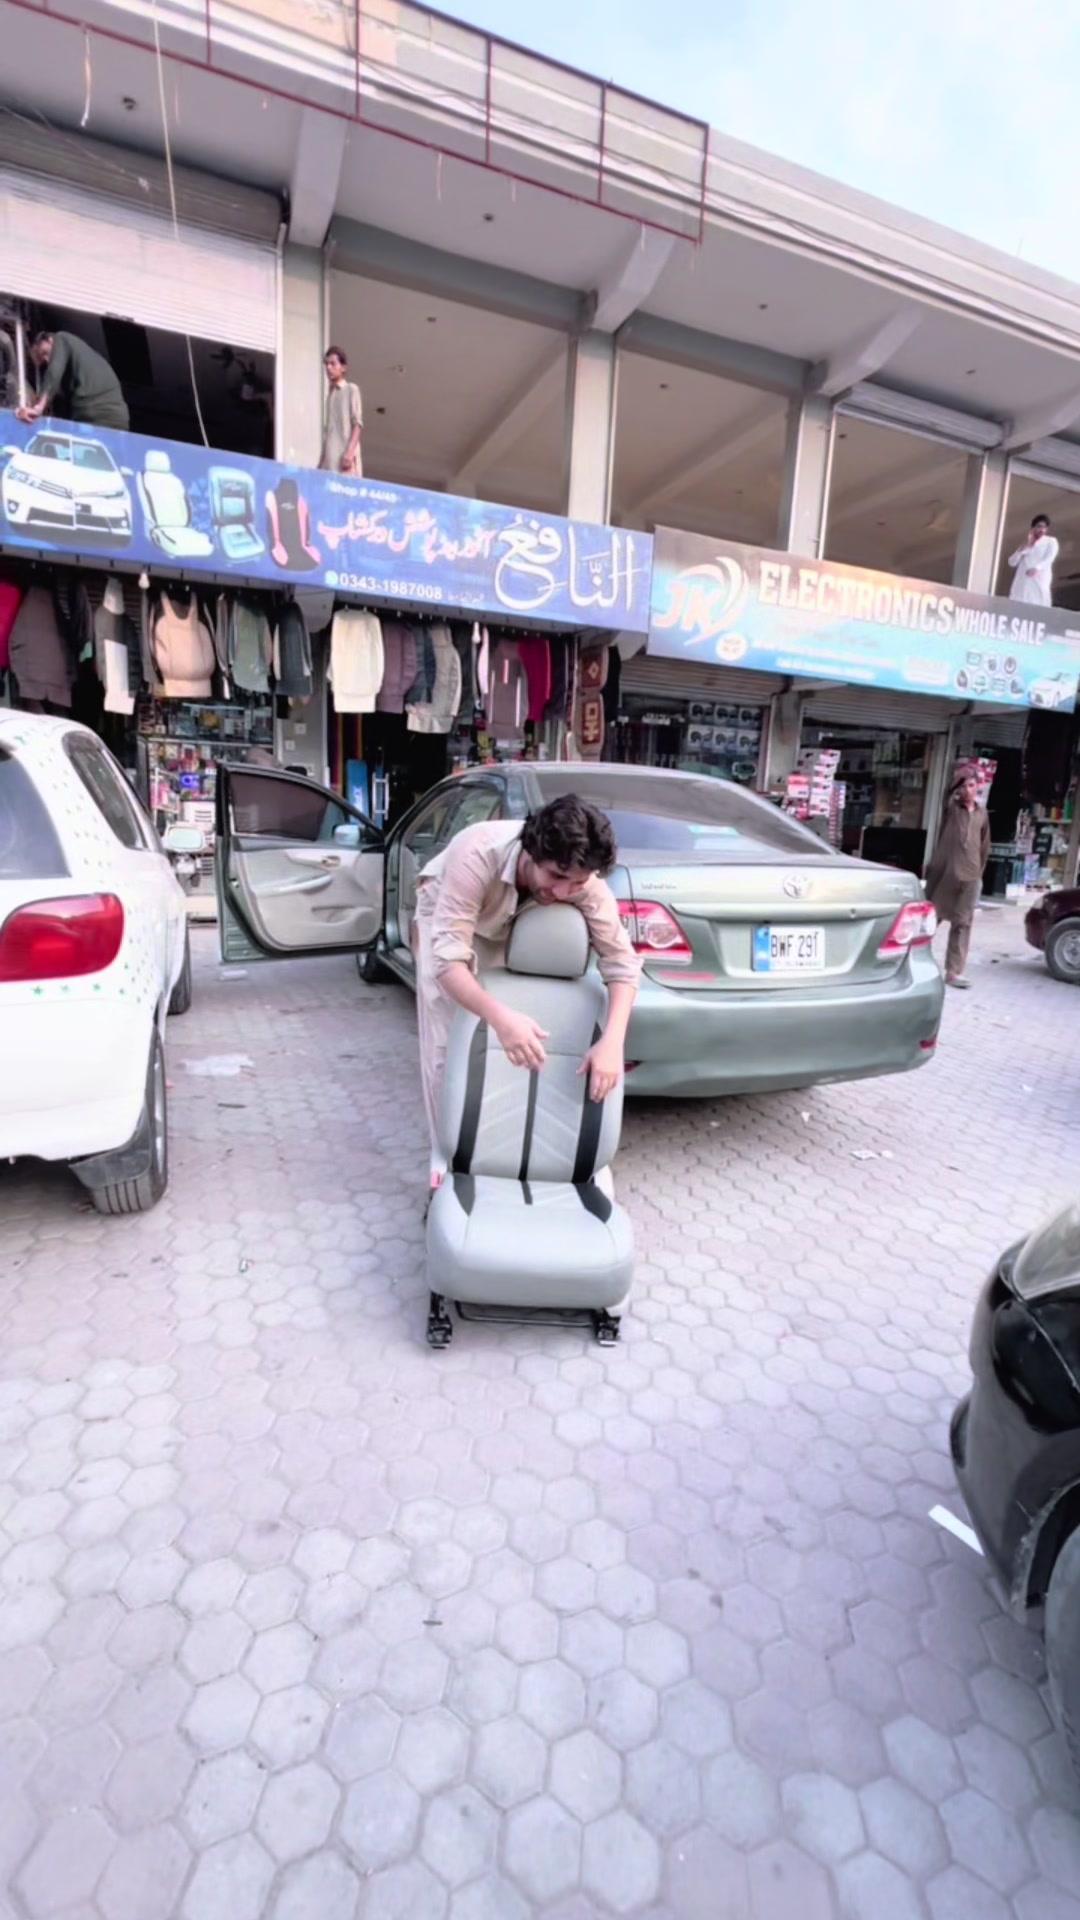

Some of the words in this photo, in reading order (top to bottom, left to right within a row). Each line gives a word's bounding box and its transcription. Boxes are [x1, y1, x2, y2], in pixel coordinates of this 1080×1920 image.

[339, 572, 442, 600] 0343-1987008
[758, 560, 956, 636] ELECTRONICS
[955, 606, 1008, 640] WHOLE
[1010, 617, 1046, 646] SALE
